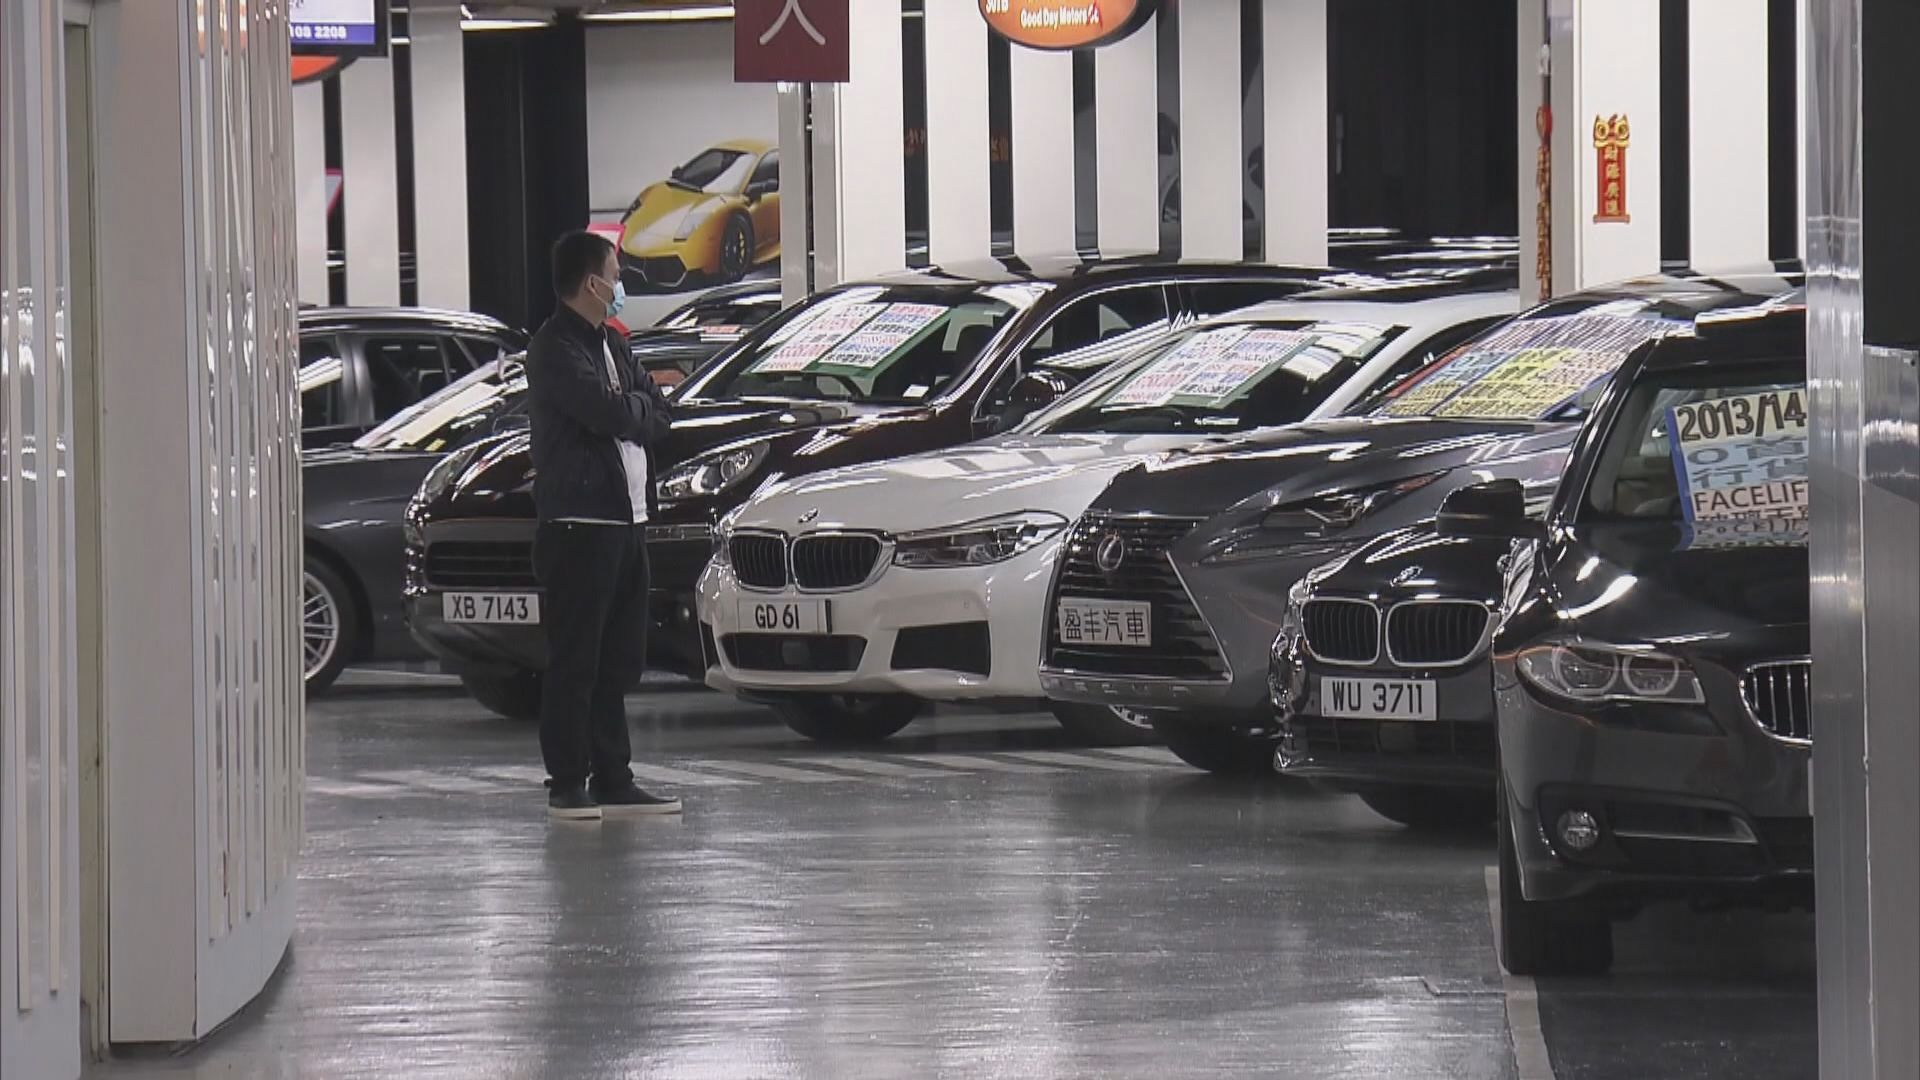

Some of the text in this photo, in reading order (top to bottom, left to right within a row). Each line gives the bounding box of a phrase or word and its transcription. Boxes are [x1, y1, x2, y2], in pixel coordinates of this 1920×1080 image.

[1020, 8, 1042, 28] Good
[1043, 8, 1059, 30] Day
[1059, 6, 1087, 25] Motors
[1677, 391, 1807, 442] 2013/14
[452, 595, 528, 620] XB 7143
[755, 604, 800, 630] GD 61
[1332, 681, 1423, 714] WU 3711
